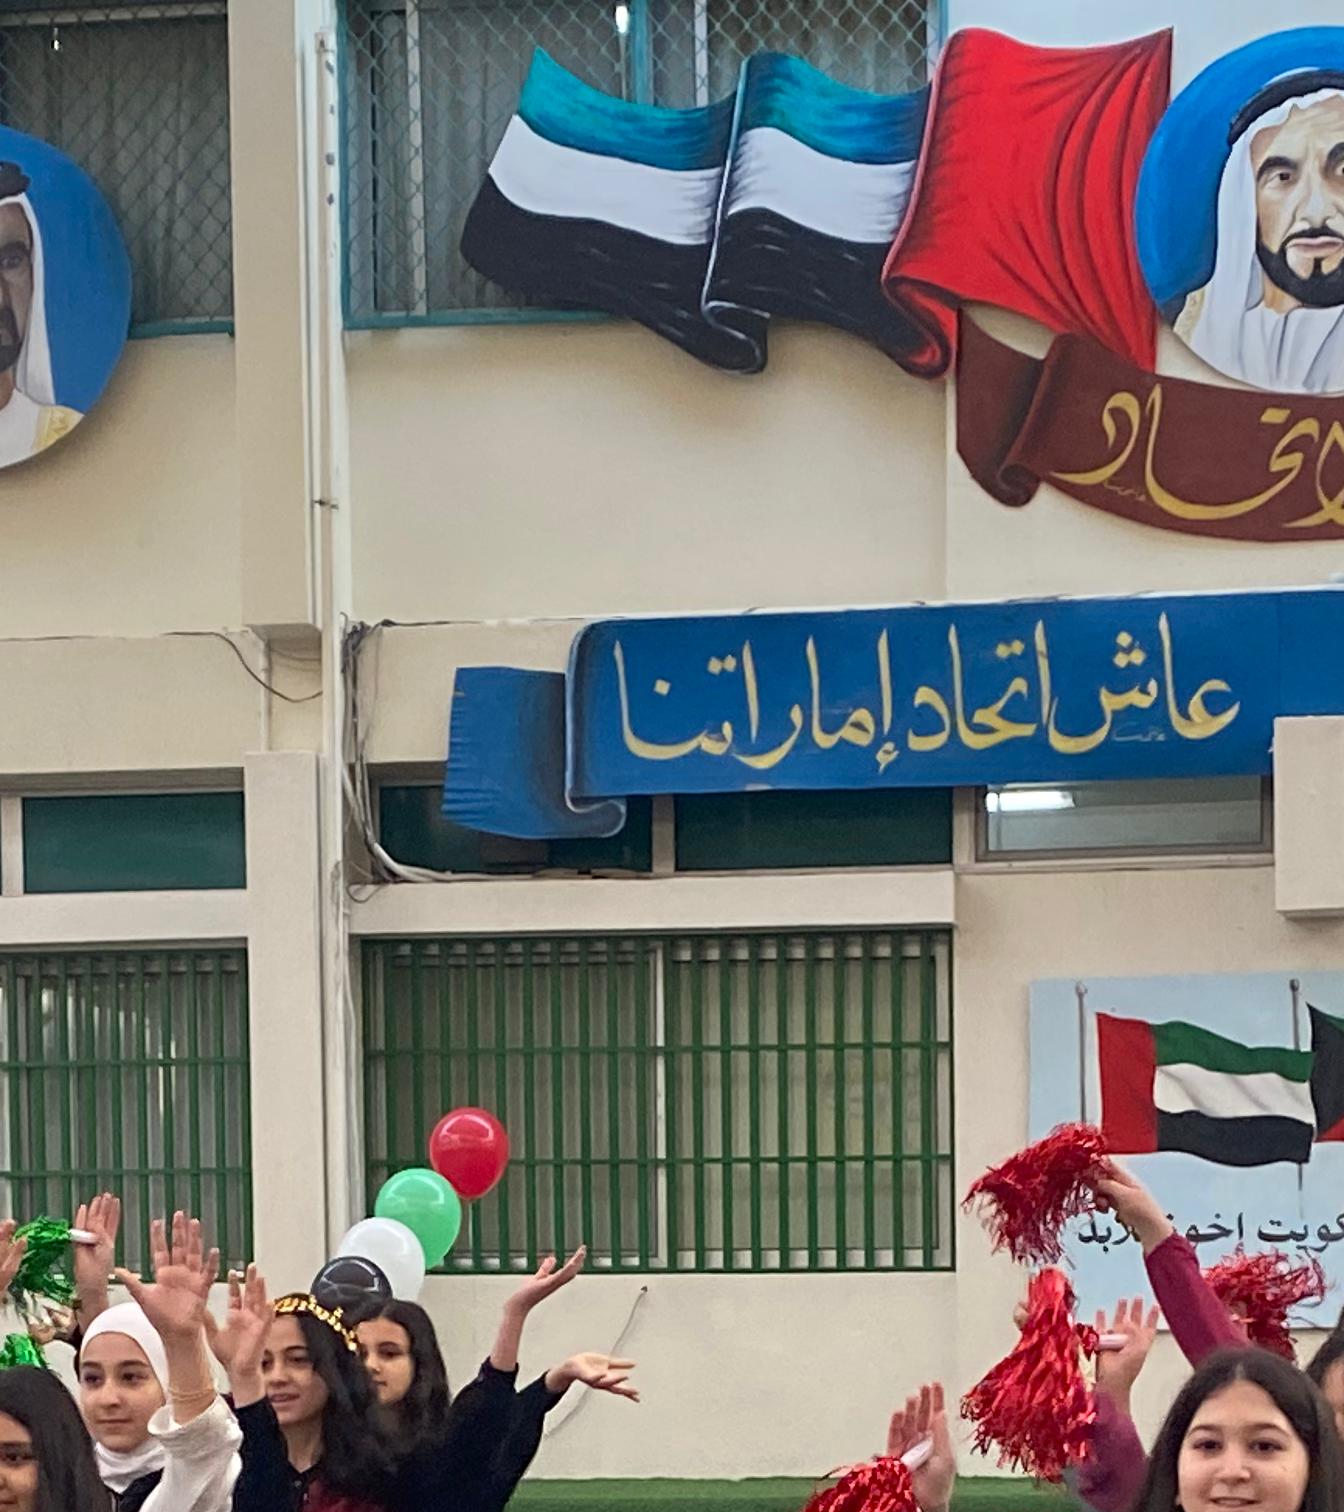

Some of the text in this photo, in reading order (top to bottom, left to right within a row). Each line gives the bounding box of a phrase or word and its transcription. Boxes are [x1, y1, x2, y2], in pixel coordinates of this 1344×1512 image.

[613, 627, 900, 774] إماراتنا
[906, 620, 1052, 753] اتحاد
[1050, 612, 1242, 755] عاش
